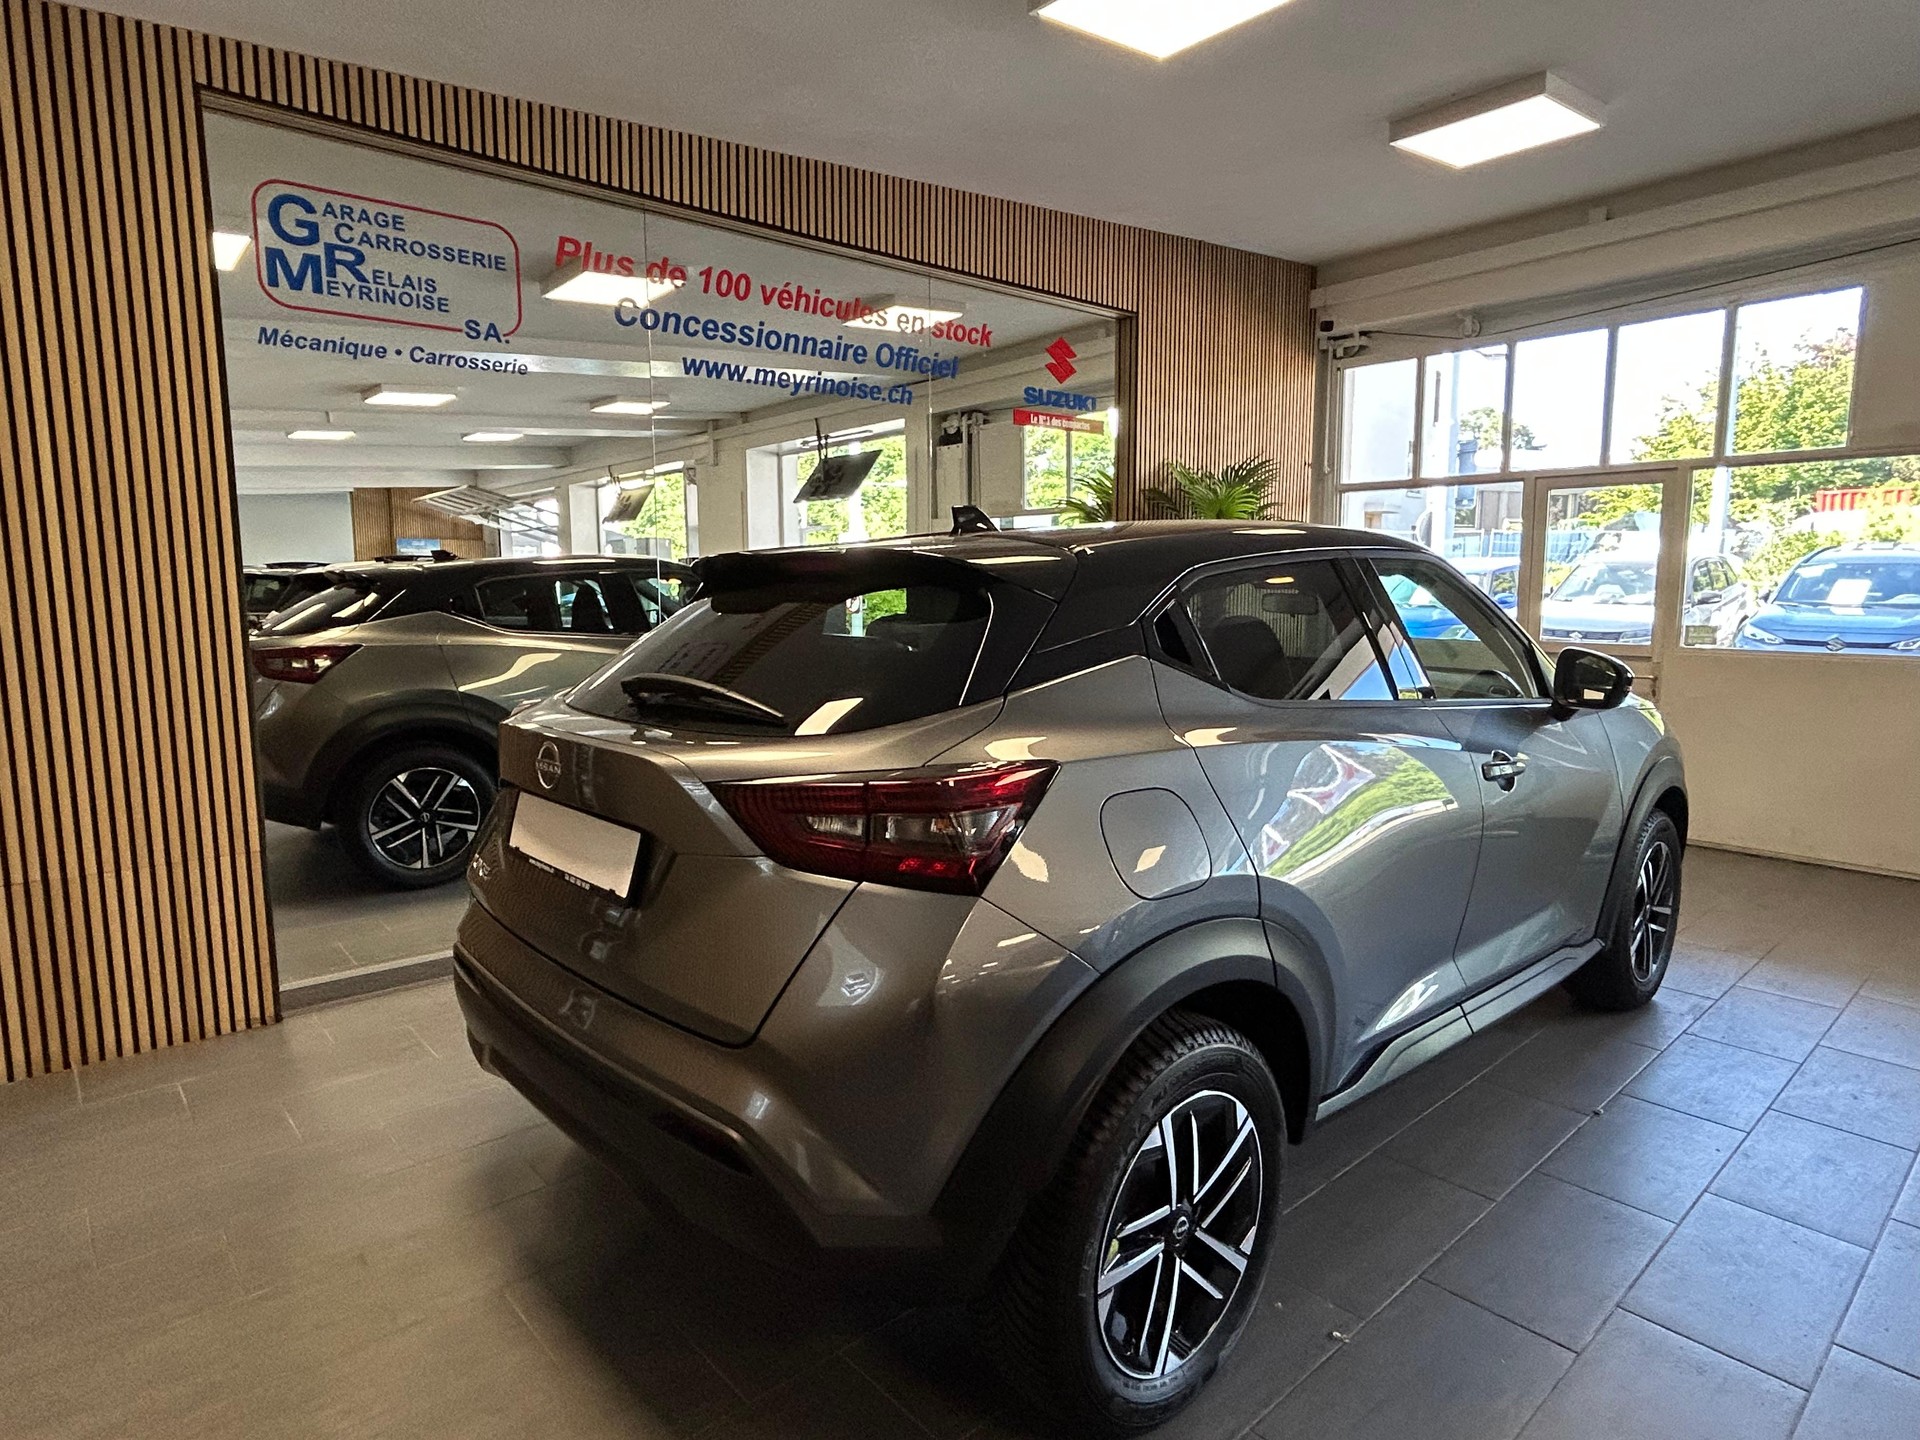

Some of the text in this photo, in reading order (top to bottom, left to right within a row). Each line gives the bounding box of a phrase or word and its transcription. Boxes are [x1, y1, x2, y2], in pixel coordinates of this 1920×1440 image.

[324, 242, 438, 294] RELAIS
[334, 224, 508, 271] CARROSSERIE
[265, 247, 449, 313] MEYRINOISE
[555, 236, 993, 348] Plus de 100 véhicules en stock
[257, 326, 528, 376] Mécanique Carrosserie
[614, 296, 959, 380] Concessionnaire Officiel
[681, 355, 914, 406] www.meyrinoise.ch
[1023, 386, 1097, 411] SUZUKI
